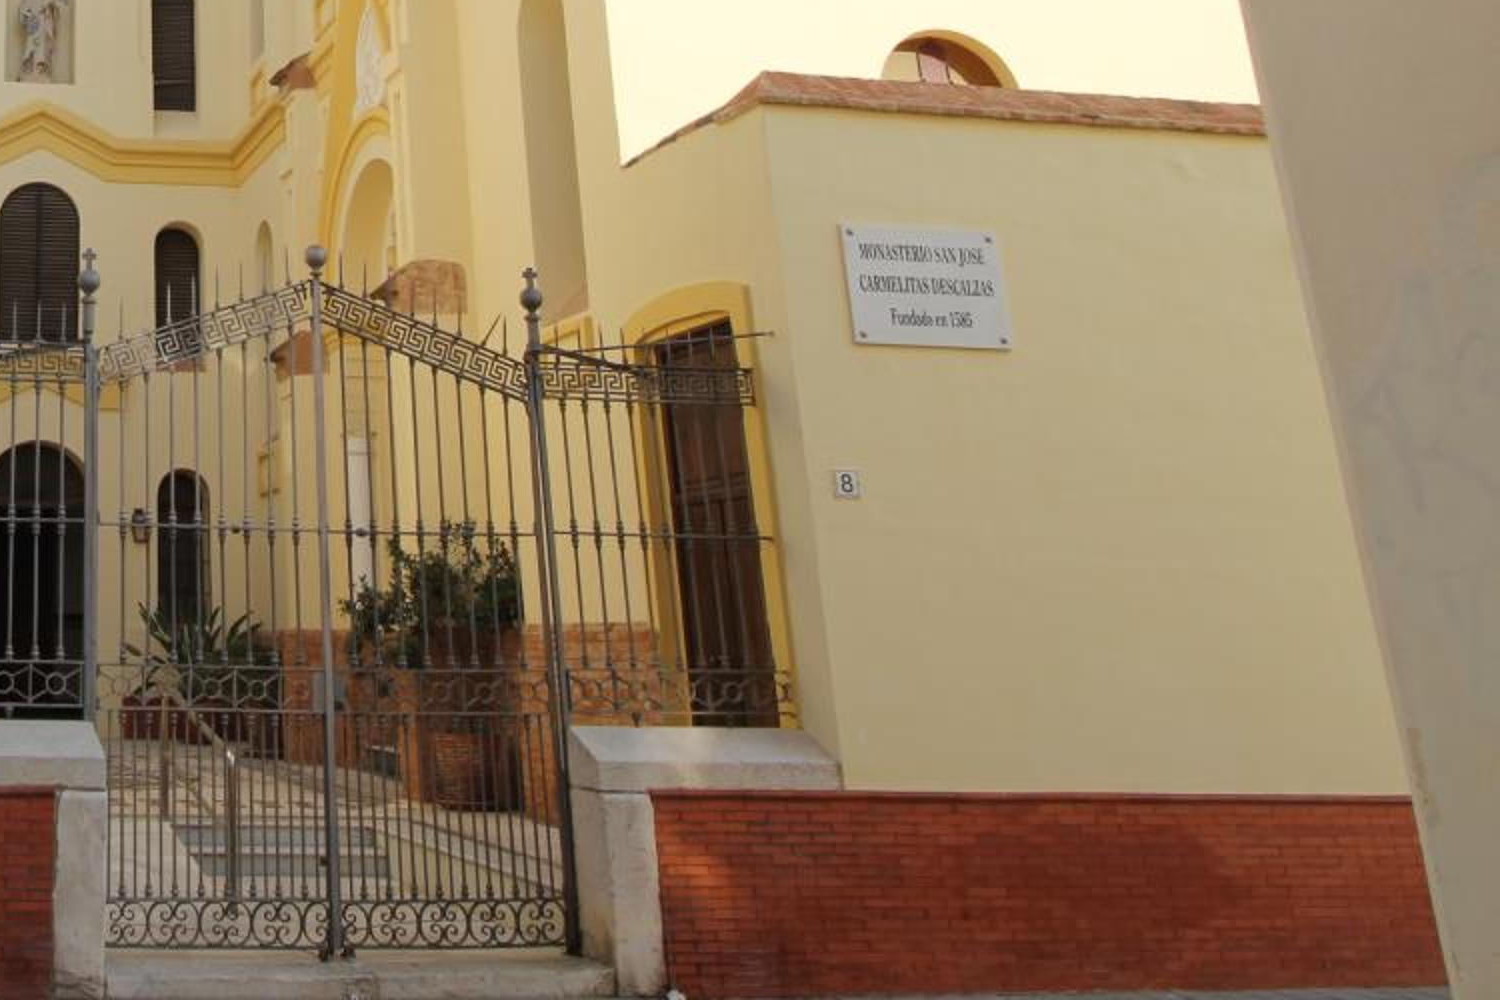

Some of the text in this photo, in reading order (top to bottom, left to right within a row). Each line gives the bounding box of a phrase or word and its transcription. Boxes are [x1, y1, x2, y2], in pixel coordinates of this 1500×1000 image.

[859, 243, 932, 262] MONASTERIO
[933, 247, 957, 263] SAN
[859, 274, 995, 296] CARMELITAS DESCALZAS
[889, 307, 933, 327] Fundado
[935, 315, 949, 327] en
[841, 473, 852, 492] 8
